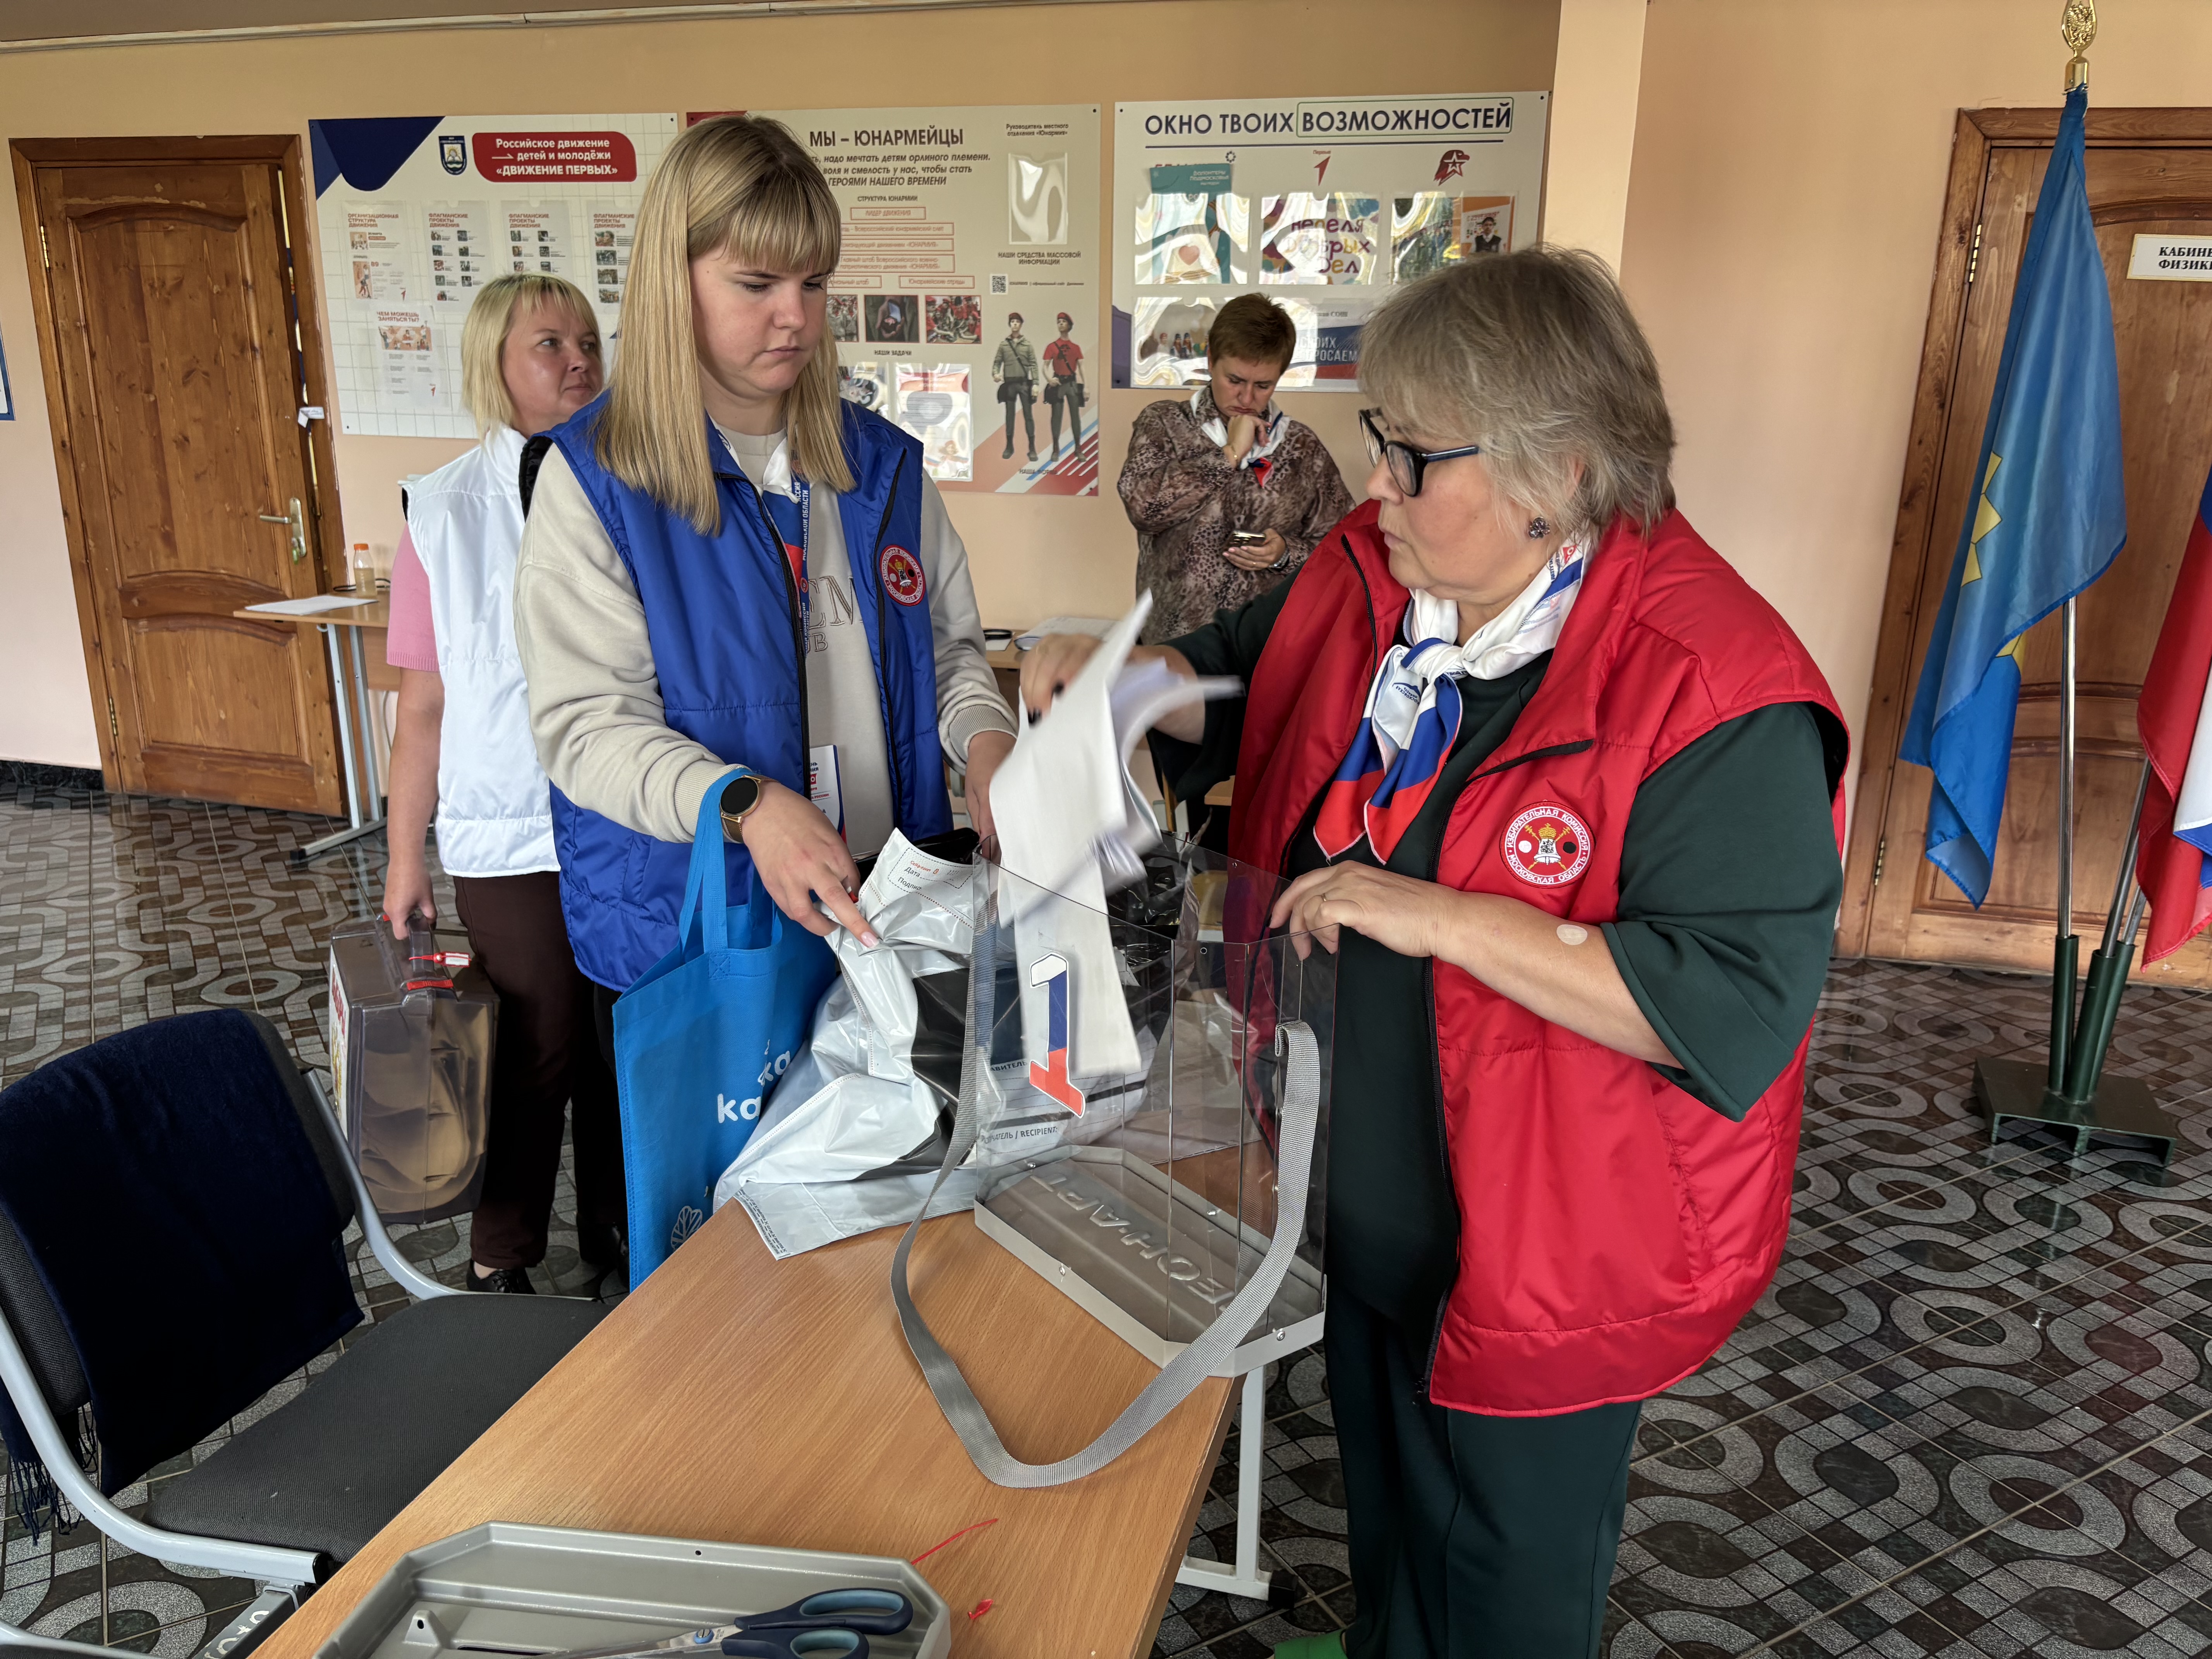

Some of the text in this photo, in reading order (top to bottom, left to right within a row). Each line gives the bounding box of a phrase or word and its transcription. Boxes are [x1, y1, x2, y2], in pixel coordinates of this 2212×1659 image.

[1145, 102, 1511, 136] ОКНО ТВОИХ ВОЗМОЖНОСТЕЙ
[810, 131, 836, 147] МЫ
[854, 125, 963, 148] ЮНАРМЕЙЦЫ
[496, 139, 610, 149] Российское движение
[517, 151, 546, 161] детей
[558, 151, 611, 161] молодёжи
[909, 155, 949, 164] орлиного
[496, 165, 618, 176] «ДВИЖЕНИЕ ПЕРВЫХ»
[893, 167, 898, 176] у
[900, 167, 918, 175] нас,
[922, 165, 947, 173] чтобы
[828, 176, 946, 187] ГЕРОЯМИ НАШЕГО ВРЕМЕНИ
[1507, 809, 1588, 850] ИЗБИРАТЕЛЬНАЯ КОМИССИЯ
[904, 867, 920, 878] Дата
[1508, 854, 1587, 883] МОСКОВСКАЯ ОБЛАСТЬ
[991, 1060, 1028, 1072] АВИТЕЛЬ
[1020, 1126, 1058, 1137] RECIPIENT:
